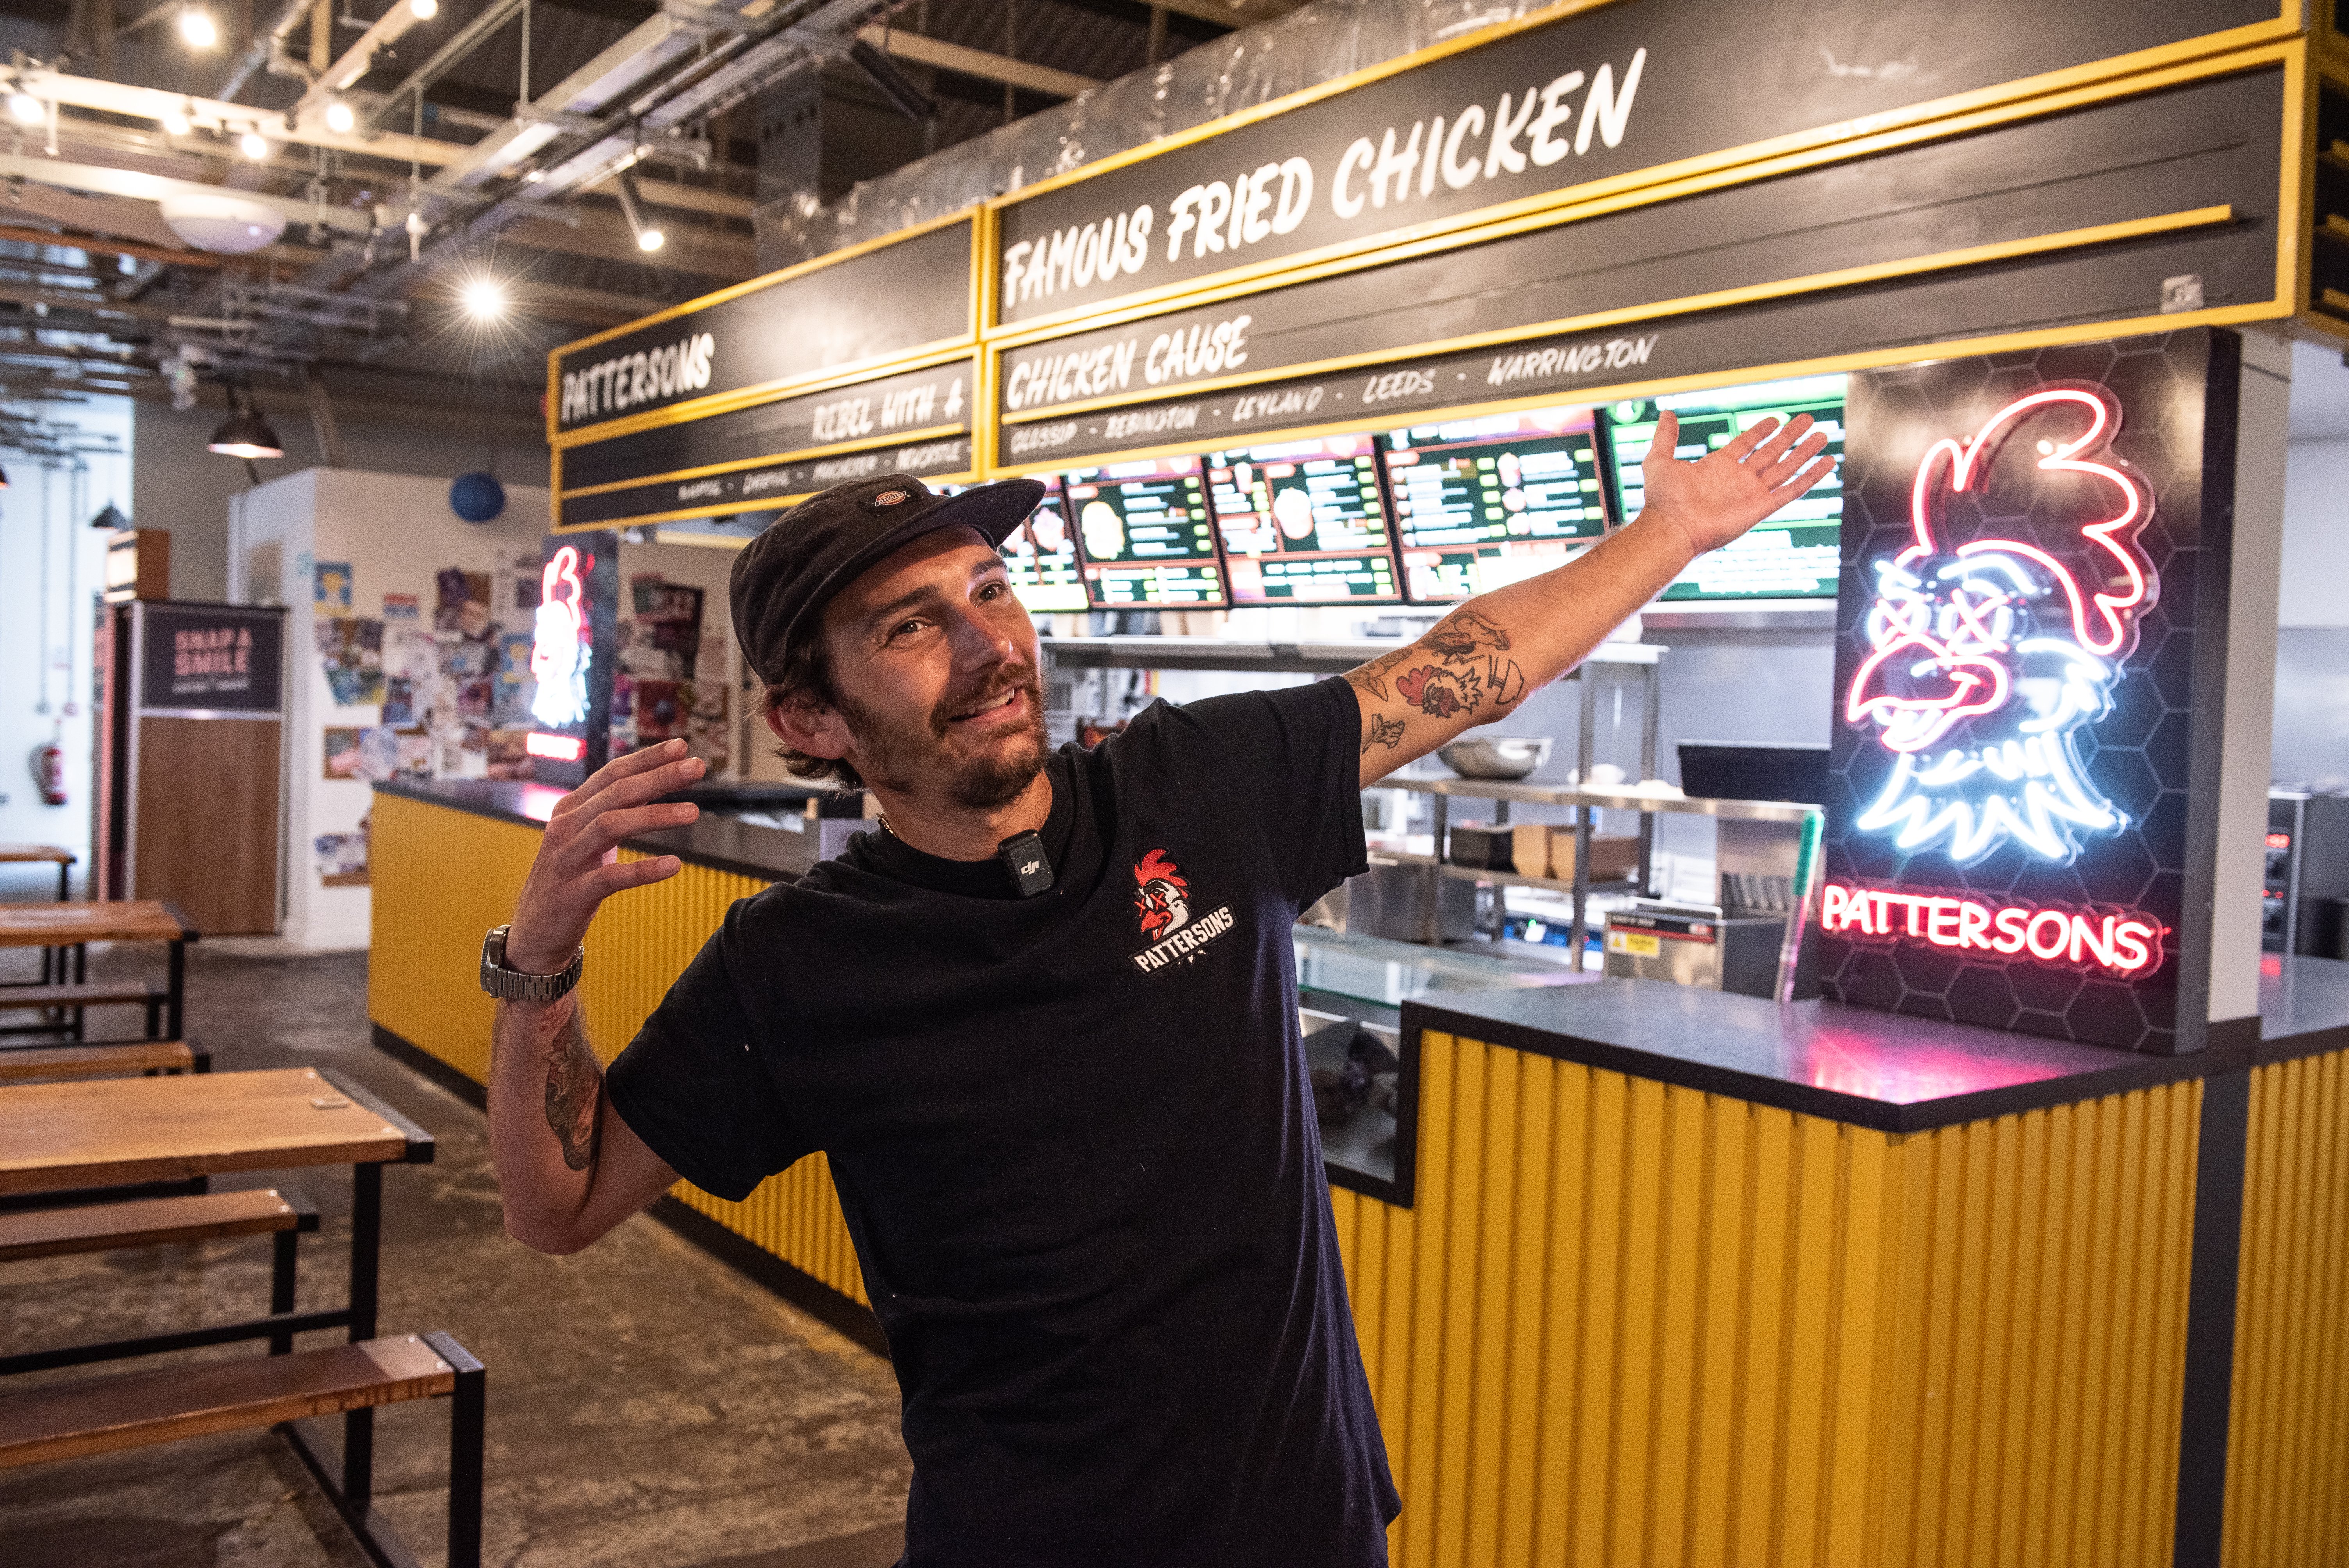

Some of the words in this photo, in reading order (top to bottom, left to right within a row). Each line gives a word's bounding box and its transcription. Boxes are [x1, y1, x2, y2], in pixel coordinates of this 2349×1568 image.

[1003, 204, 1153, 307] FAMOUS
[1167, 156, 1313, 262] FRIED
[1331, 46, 1647, 219] CHICKEN
[561, 332, 715, 423] PATTERSONS
[1006, 338, 1137, 410] CHICKEN
[1145, 315, 1252, 385] CAUSE
[1105, 404, 1200, 440] BEBINGTON
[1232, 385, 1324, 422] LEYLAND
[1362, 368, 1435, 403] LEEDS
[1487, 333, 1659, 385] WARRINGTON
[813, 397, 874, 441] REBEL
[880, 384, 937, 429] WITH
[944, 378, 964, 418] A
[878, 492, 904, 504] Dickies
[1134, 907, 1234, 973] PATTERSONS
[1821, 884, 2153, 970] PATTERSONS
